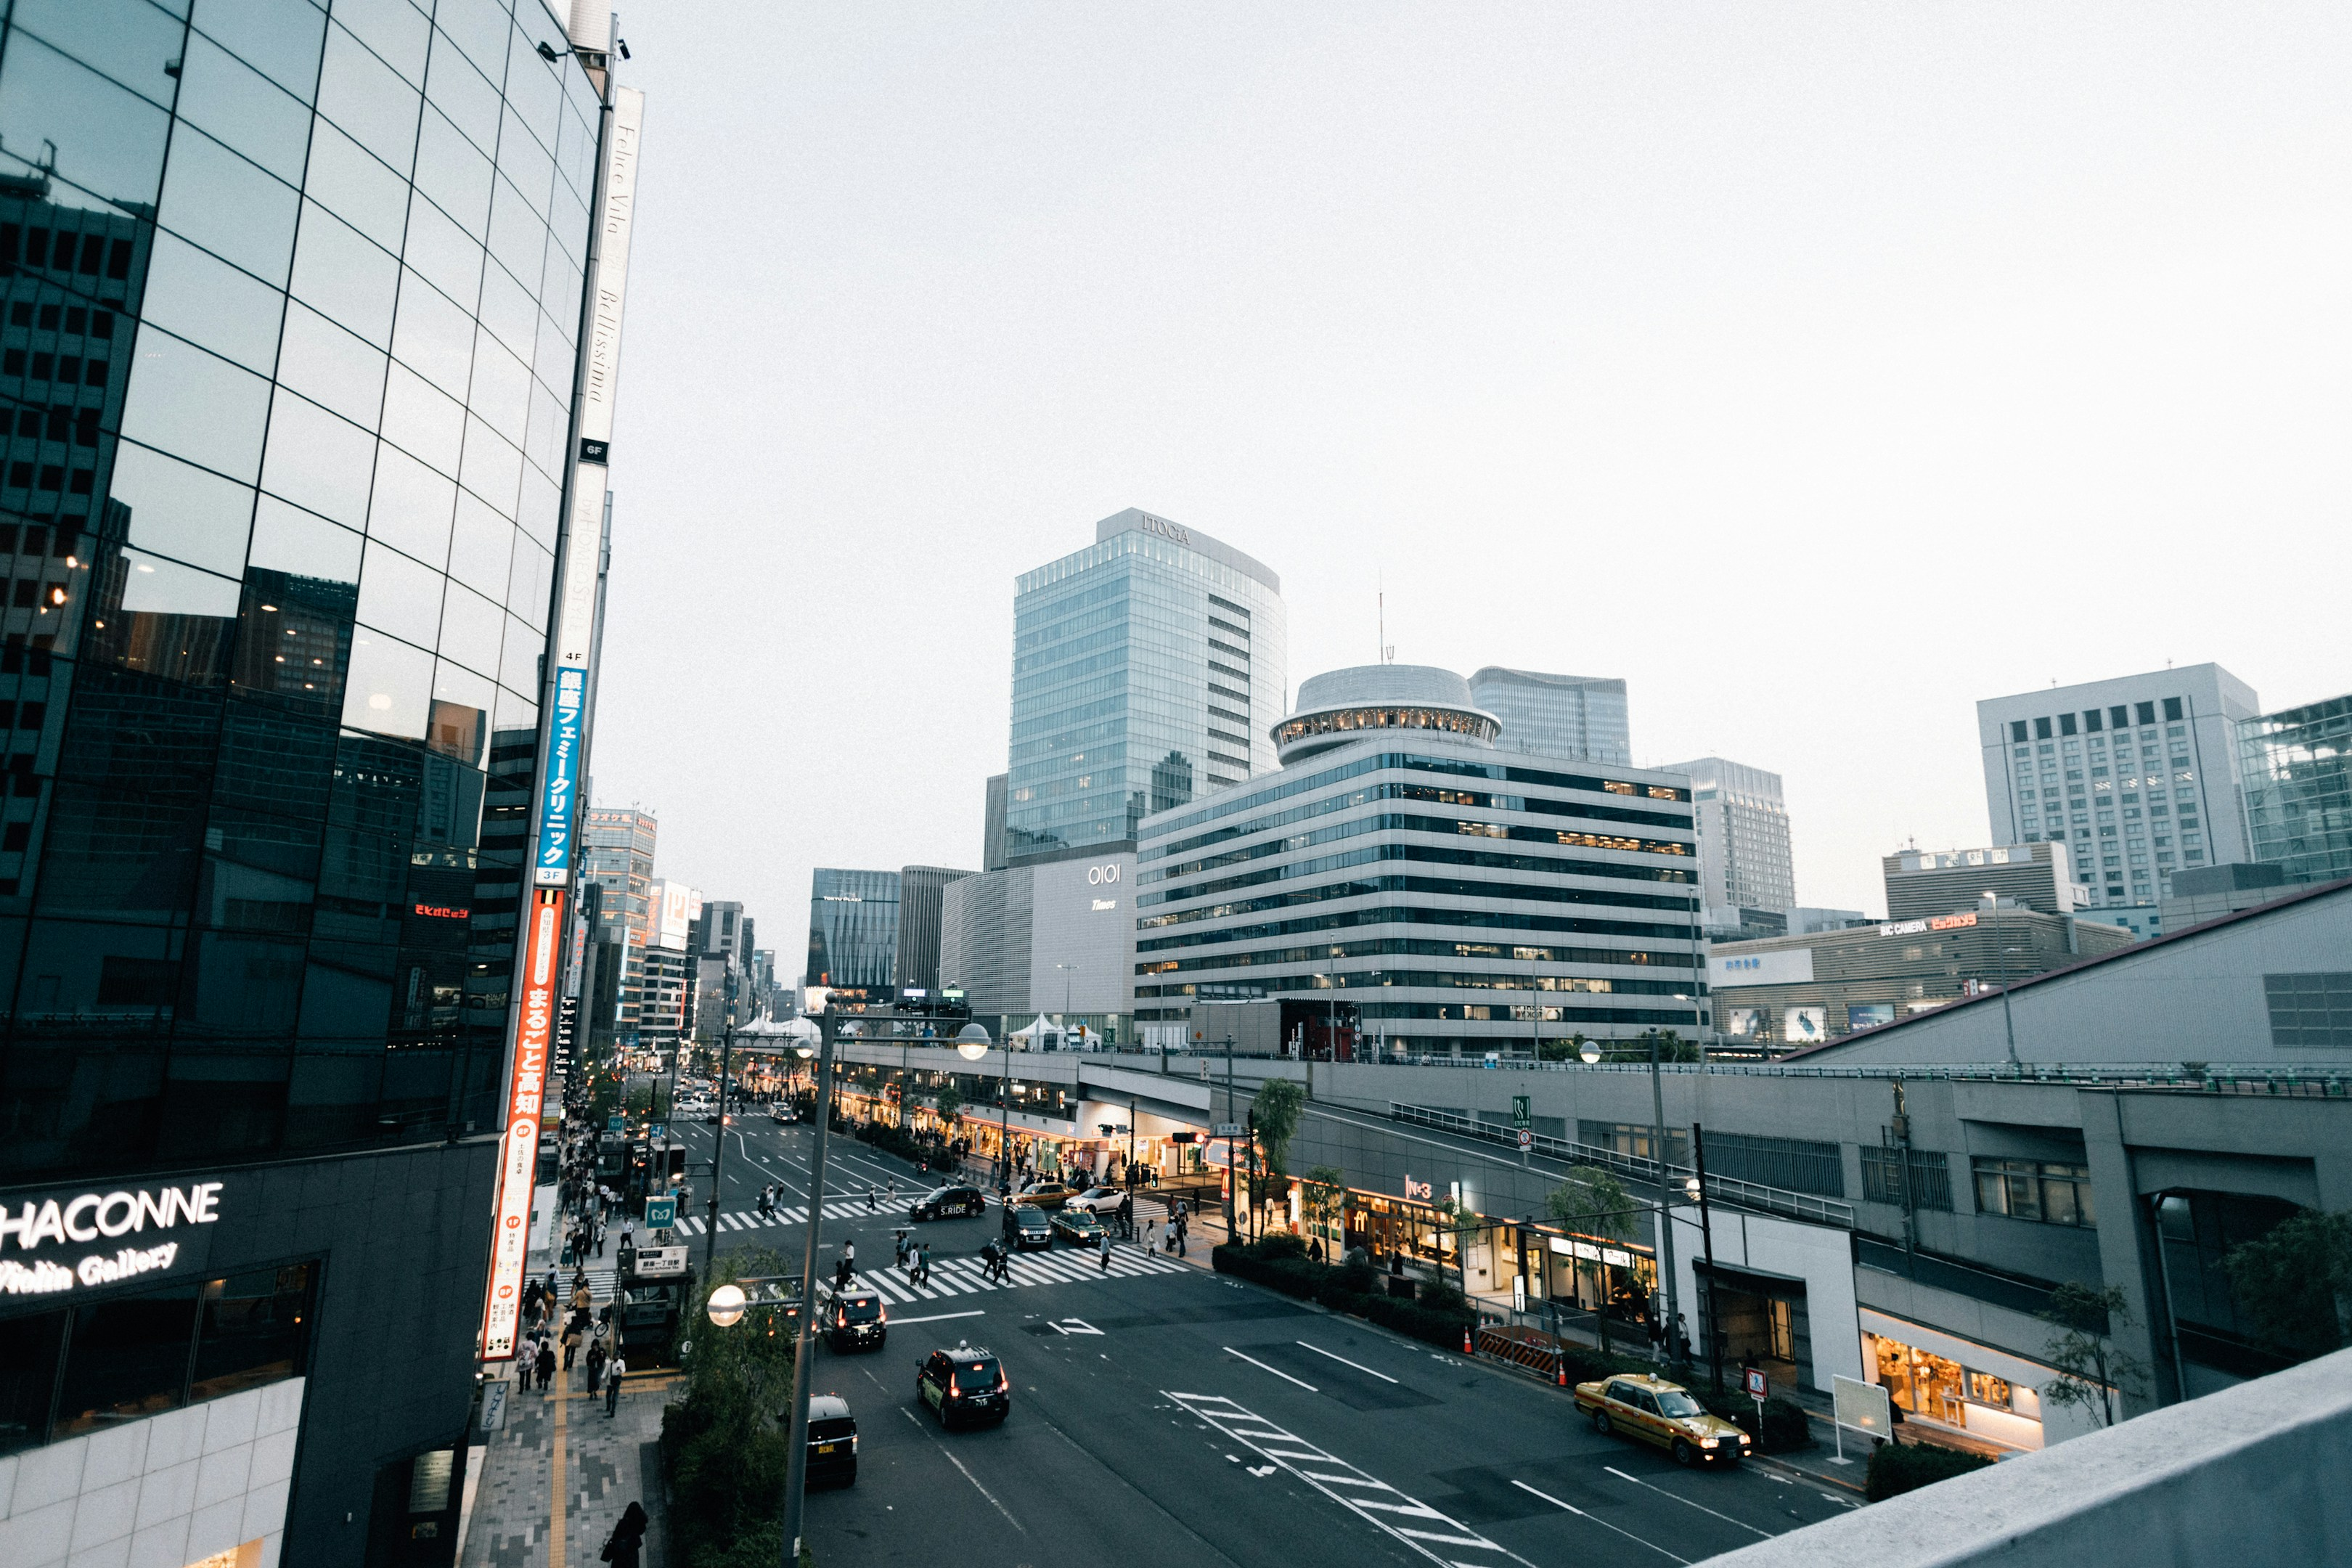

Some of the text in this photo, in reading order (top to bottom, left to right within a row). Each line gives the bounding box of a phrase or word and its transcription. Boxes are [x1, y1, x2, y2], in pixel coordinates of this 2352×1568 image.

[608, 125, 635, 234] Felice Vita
[589, 288, 619, 403] Bellissima
[587, 445, 603, 455] 6F
[565, 653, 582, 661] 4F
[544, 670, 583, 865] 銀座フェミークリニック
[544, 870, 560, 880] 3F
[1091, 898, 1116, 912] Times
[1880, 920, 1928, 936] BIC CAMERA
[1931, 912, 1978, 931] ビックカメラ
[515, 988, 550, 1116] まるごと高知
[940, 1206, 966, 1216] S.RIDE
[78, 1241, 179, 1286] Gallery
